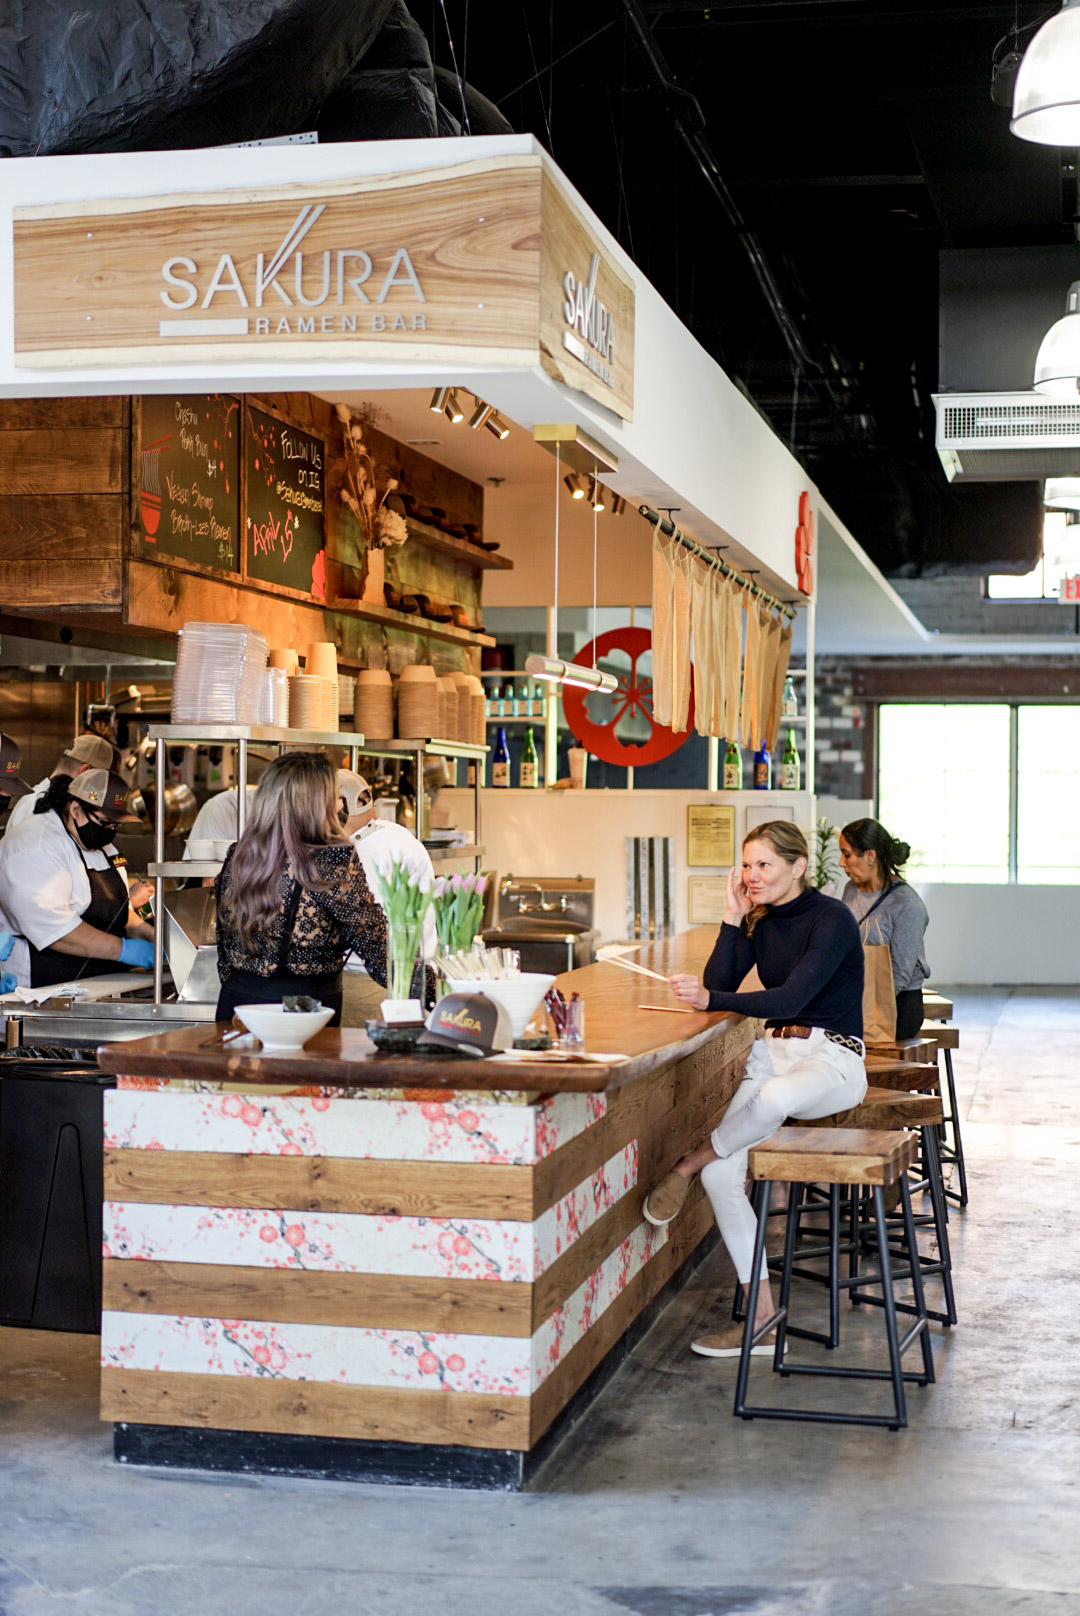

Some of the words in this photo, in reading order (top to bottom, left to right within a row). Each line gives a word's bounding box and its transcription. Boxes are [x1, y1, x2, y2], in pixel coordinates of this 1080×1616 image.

[159, 203, 427, 310] SAKURA
[255, 315, 358, 336] RAMEN
[371, 312, 429, 334] BAR
[563, 252, 615, 366] SAKURA
[439, 1008, 482, 1033] SAKURA
